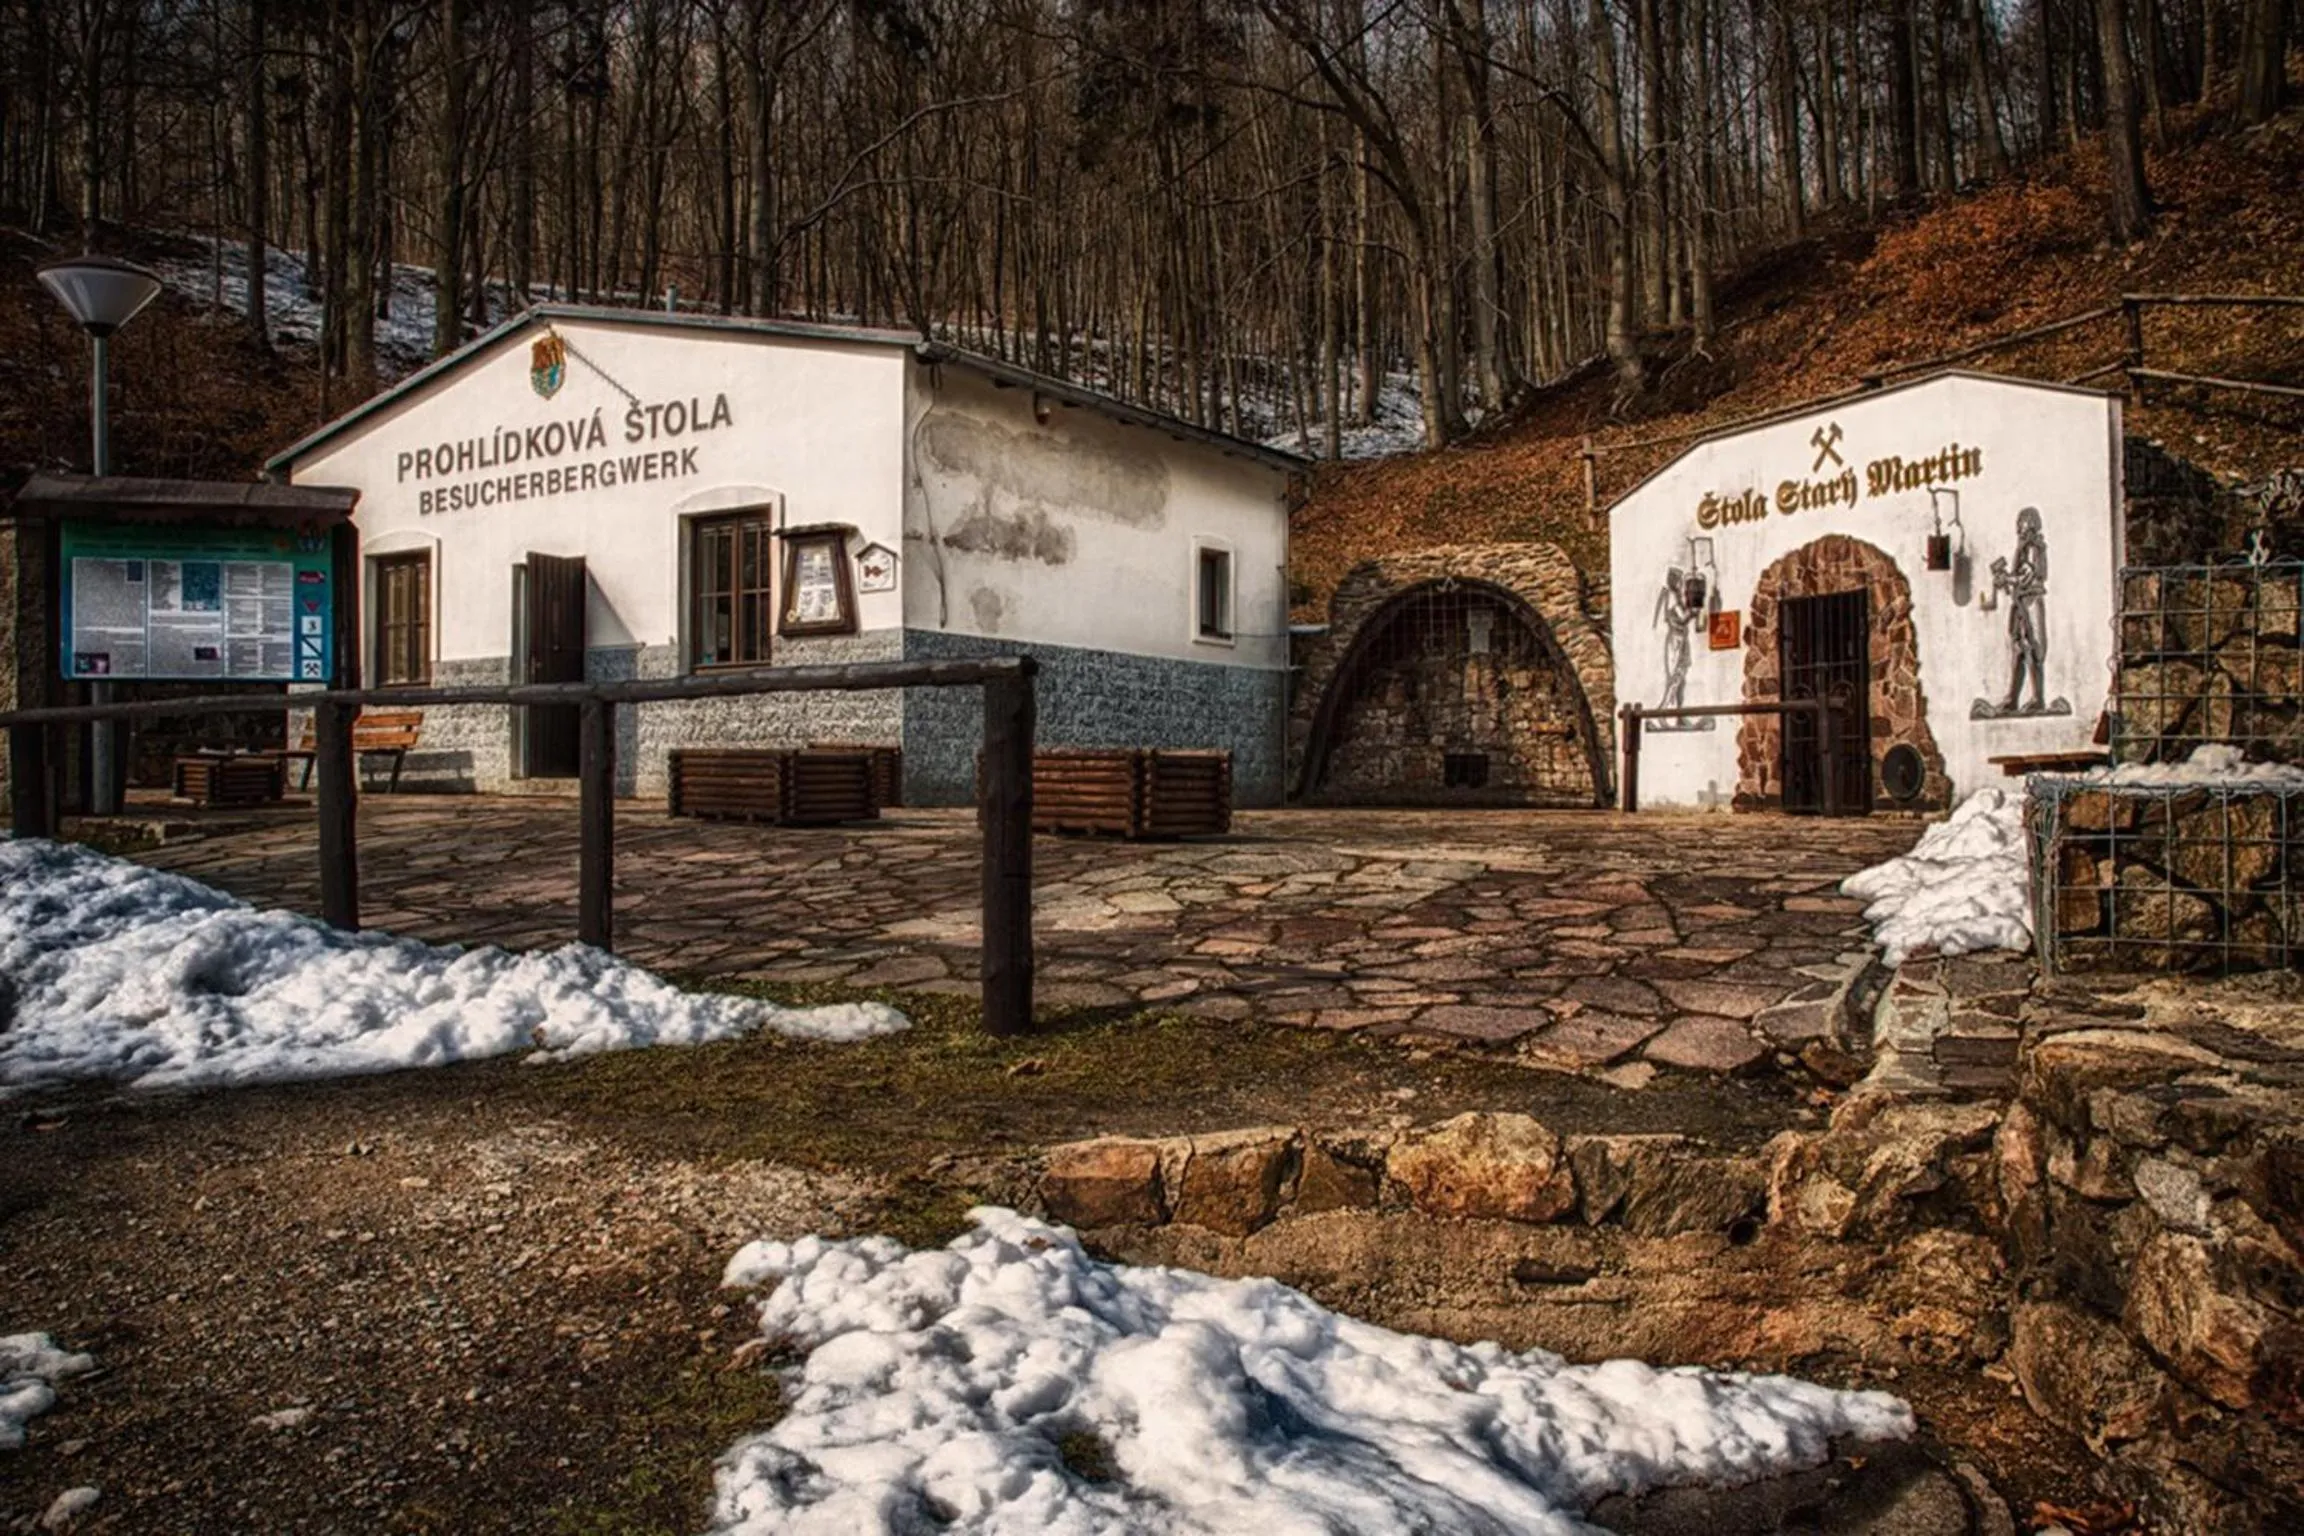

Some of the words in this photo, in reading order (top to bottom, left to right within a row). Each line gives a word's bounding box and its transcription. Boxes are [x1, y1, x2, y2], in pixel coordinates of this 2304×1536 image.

[397, 407, 607, 483] PROHLÍDKOVÁ
[624, 393, 733, 443] ŠTOLA
[419, 446, 700, 516] BESUCHERBERGWERK
[1697, 488, 1768, 530] Štola
[1775, 466, 1858, 514] Starý
[1866, 442, 1983, 497] Martin
